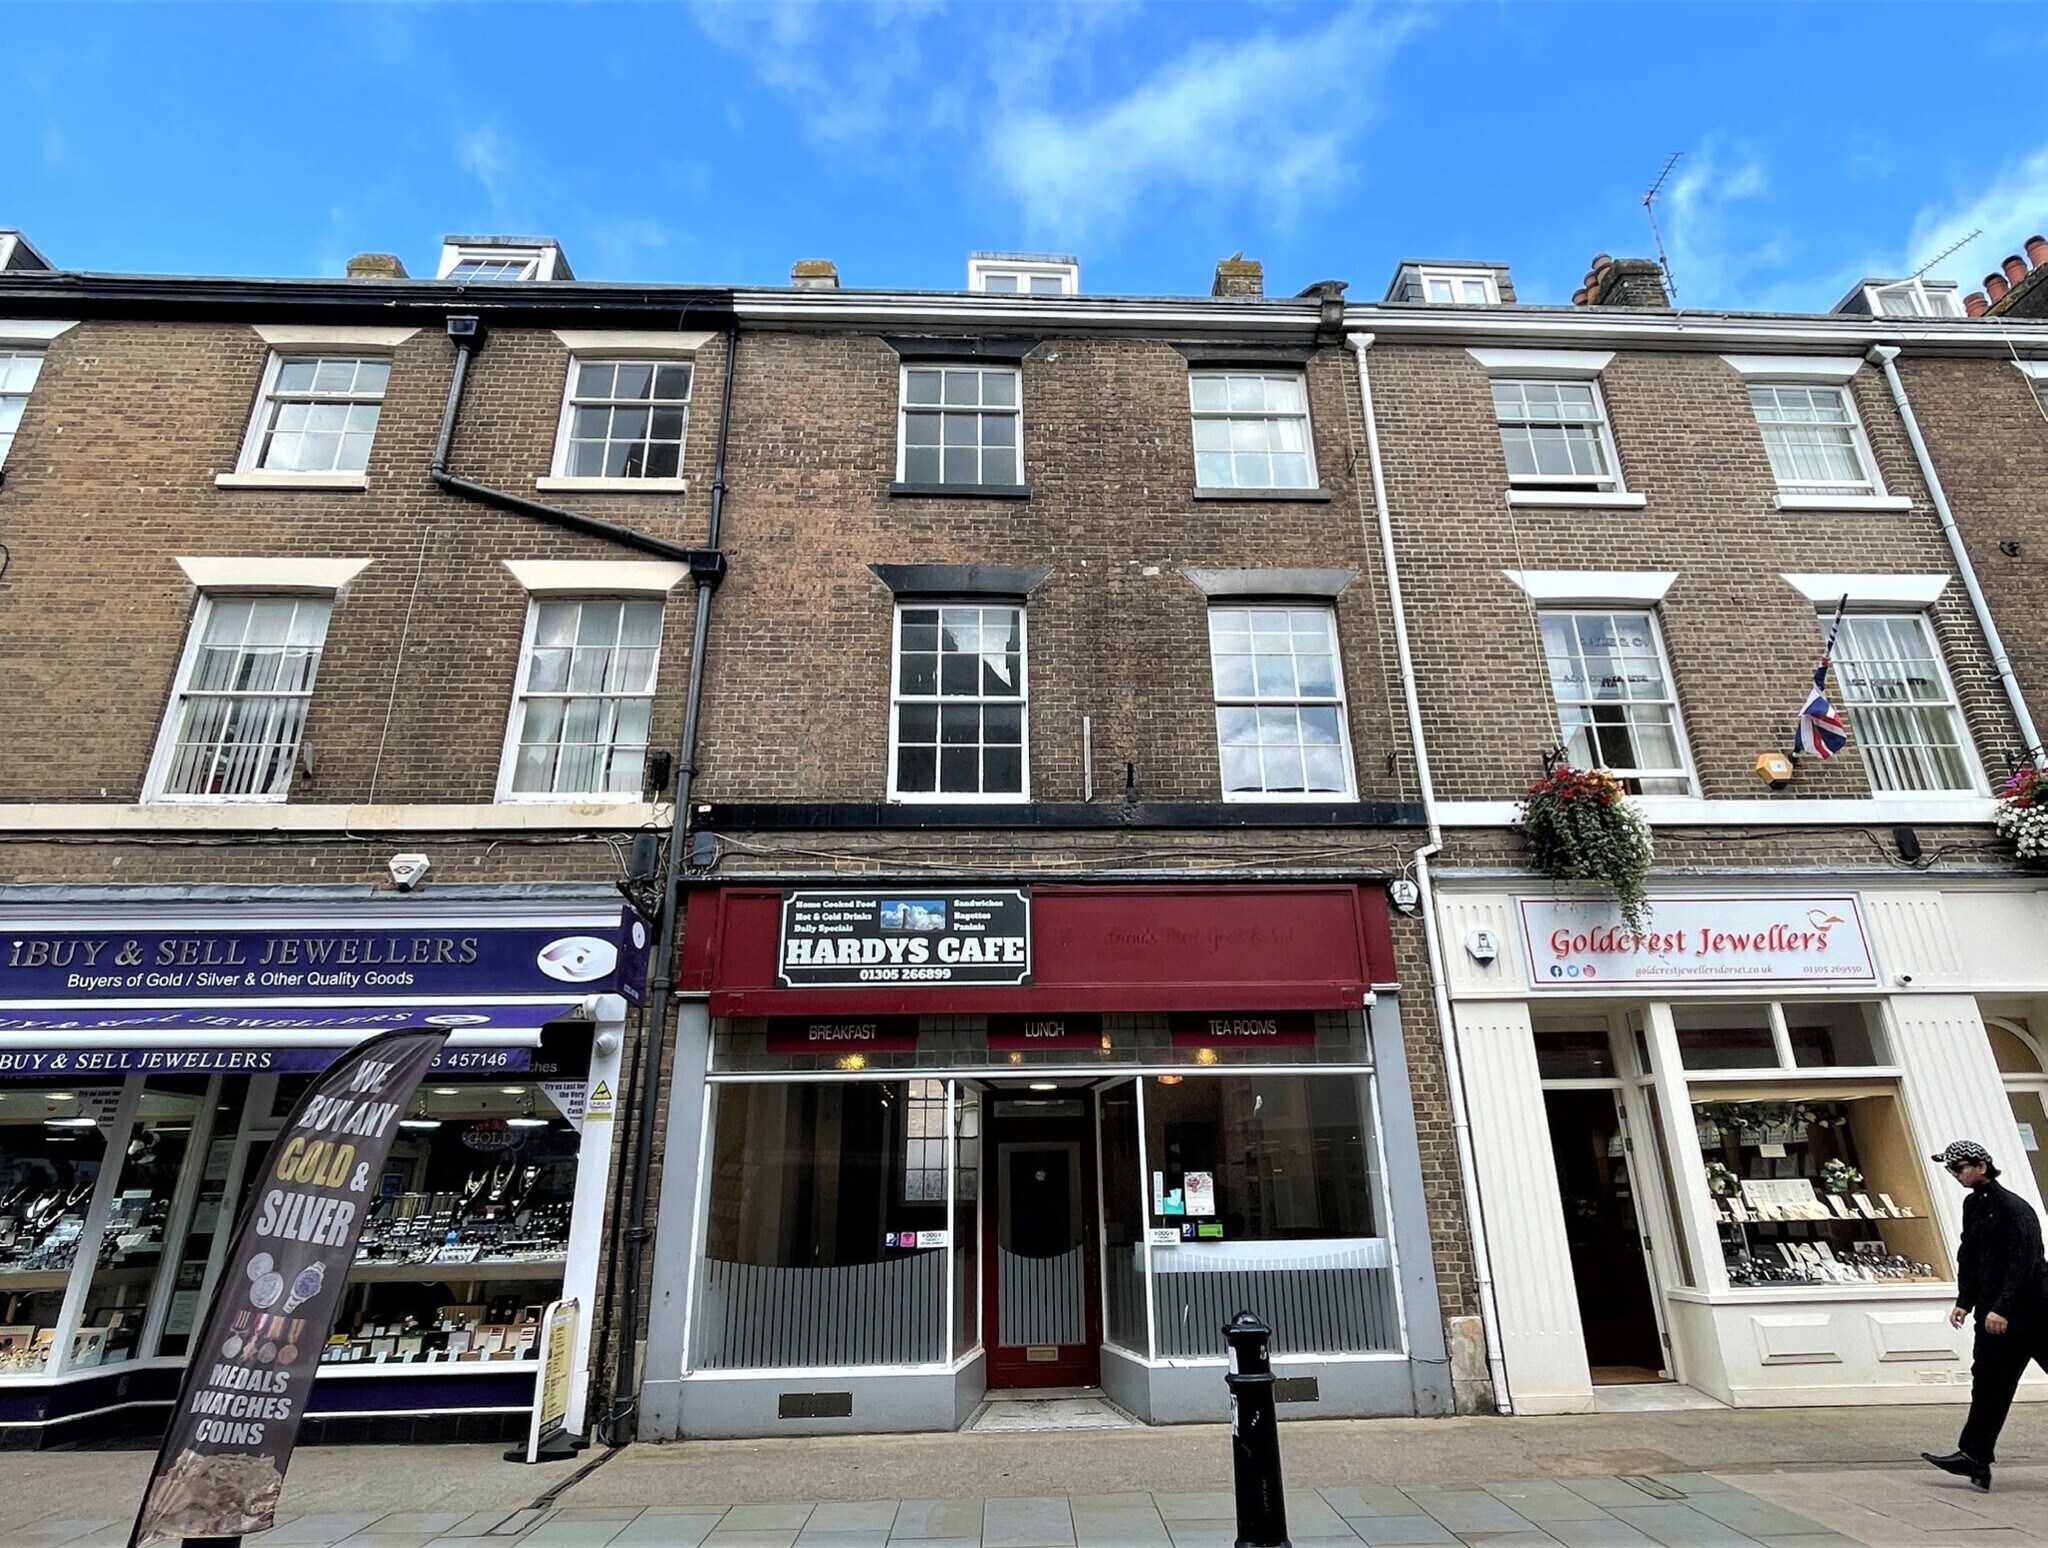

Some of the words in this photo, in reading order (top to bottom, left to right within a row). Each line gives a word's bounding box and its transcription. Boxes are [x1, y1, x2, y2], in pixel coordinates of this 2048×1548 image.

[796, 900, 821, 908] Home
[822, 900, 855, 908] Cooked
[856, 900, 877, 908] Food
[953, 899, 1004, 907] Sandwiches
[795, 913, 812, 921] Hot
[822, 913, 842, 921] Cold
[843, 912, 872, 920] Drinks
[794, 924, 818, 933] Daily
[818, 924, 854, 933] Specials
[953, 923, 986, 931] Paninis
[1551, 925, 1687, 959] Goldcrest
[1695, 924, 1828, 957] Jewellers
[9, 940, 109, 967] iBUY
[115, 940, 143, 966] &
[155, 939, 246, 966] SELL
[259, 937, 478, 965] JEWELLERS
[785, 938, 930, 965] HARDYS
[938, 937, 1025, 963] CAFE
[859, 969, 899, 980] 01305
[901, 968, 952, 980] 266899
[1635, 964, 1773, 977] goldcrestjewellersdorset.co.uk
[1803, 965, 1829, 974] 01305
[67, 973, 122, 990] Buyers
[126, 973, 144, 987] of
[146, 973, 183, 987] Gold
[185, 974, 193, 987] /
[196, 973, 240, 986] Silver
[244, 973, 256, 986] &
[260, 972, 304, 986] Other
[307, 971, 360, 988] Quality
[364, 971, 414, 986] Goods
[188, 1012, 414, 1028] JEWELLERS
[1208, 1020, 1231, 1035] TEA
[1234, 1019, 1277, 1035] ROOMS
[809, 1024, 877, 1040] BREAKFAST
[1025, 1022, 1065, 1037] LUNCH
[50, 1053, 68, 1069] &
[75, 1053, 132, 1069] SELL
[137, 1053, 272, 1068] JEWELLERS
[448, 1053, 508, 1067] 457146
[350, 1060, 396, 1094] WE
[298, 1094, 354, 1132] BUY
[343, 1101, 399, 1138] ANY
[468, 1132, 514, 1145] GOLD
[276, 1136, 356, 1188] GOLD
[350, 1161, 370, 1192] &
[255, 1189, 356, 1247] SILVER
[208, 1363, 291, 1393] MEDALS
[190, 1390, 292, 1420] WATCHES
[195, 1418, 265, 1445] COINS
